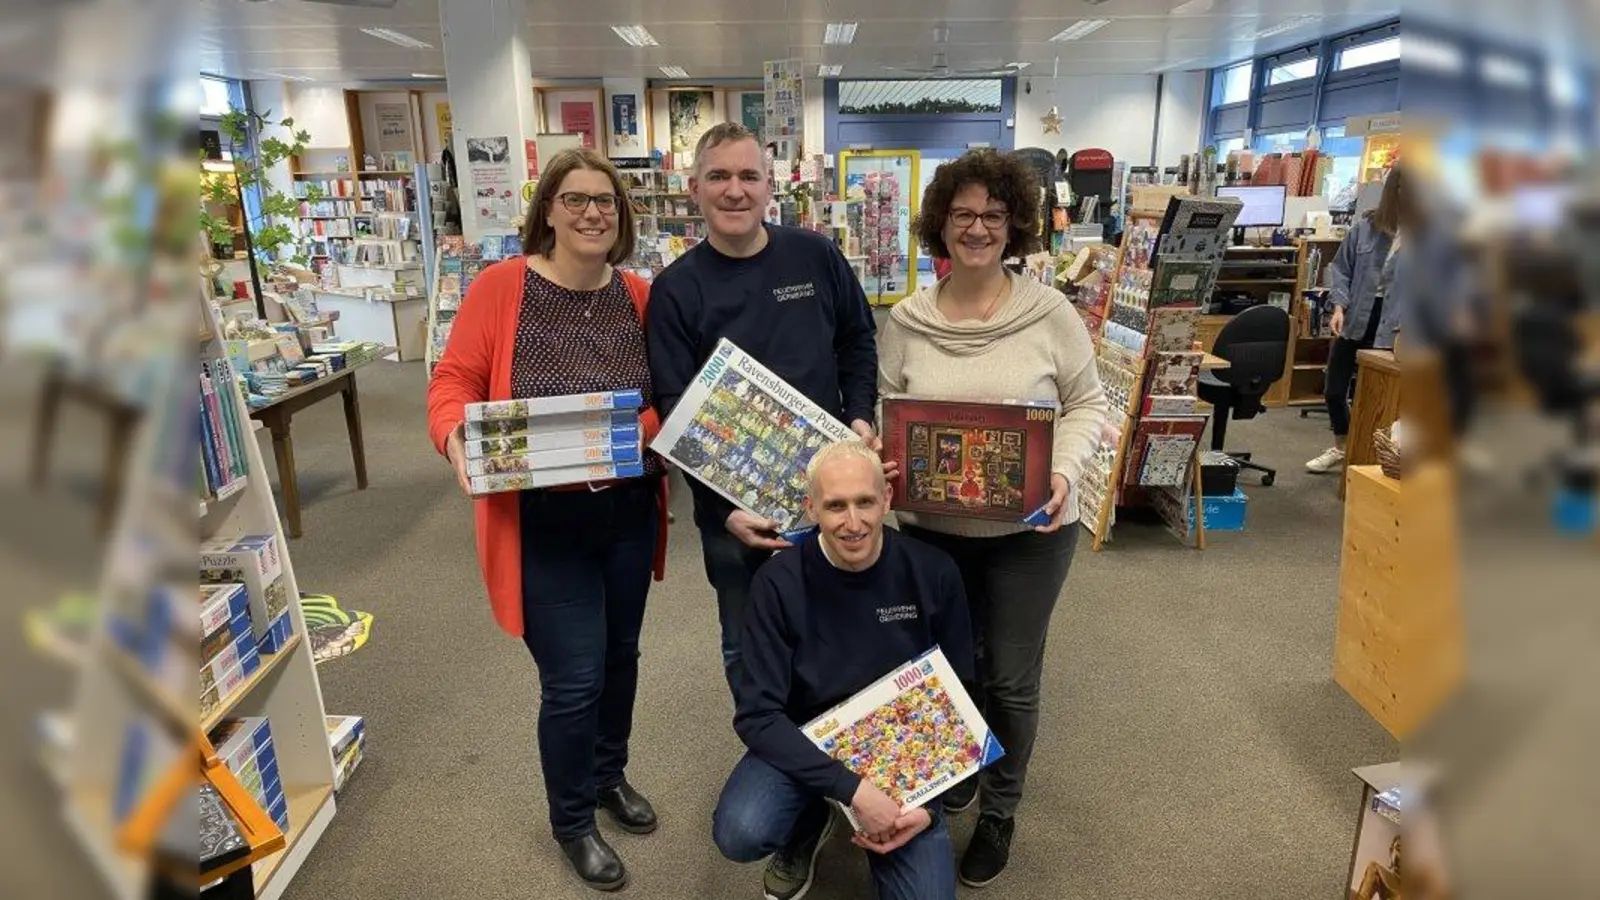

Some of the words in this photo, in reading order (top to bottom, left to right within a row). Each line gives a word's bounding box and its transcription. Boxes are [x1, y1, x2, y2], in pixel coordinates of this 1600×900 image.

[699, 355, 727, 389] 2000
[737, 355, 808, 415] Ravensburger
[814, 412, 849, 440] Puzzle
[1026, 409, 1053, 422] 1000
[203, 555, 237, 568] Puzzle
[893, 666, 924, 691] 1000
[904, 773, 950, 804] CHALLENGE
